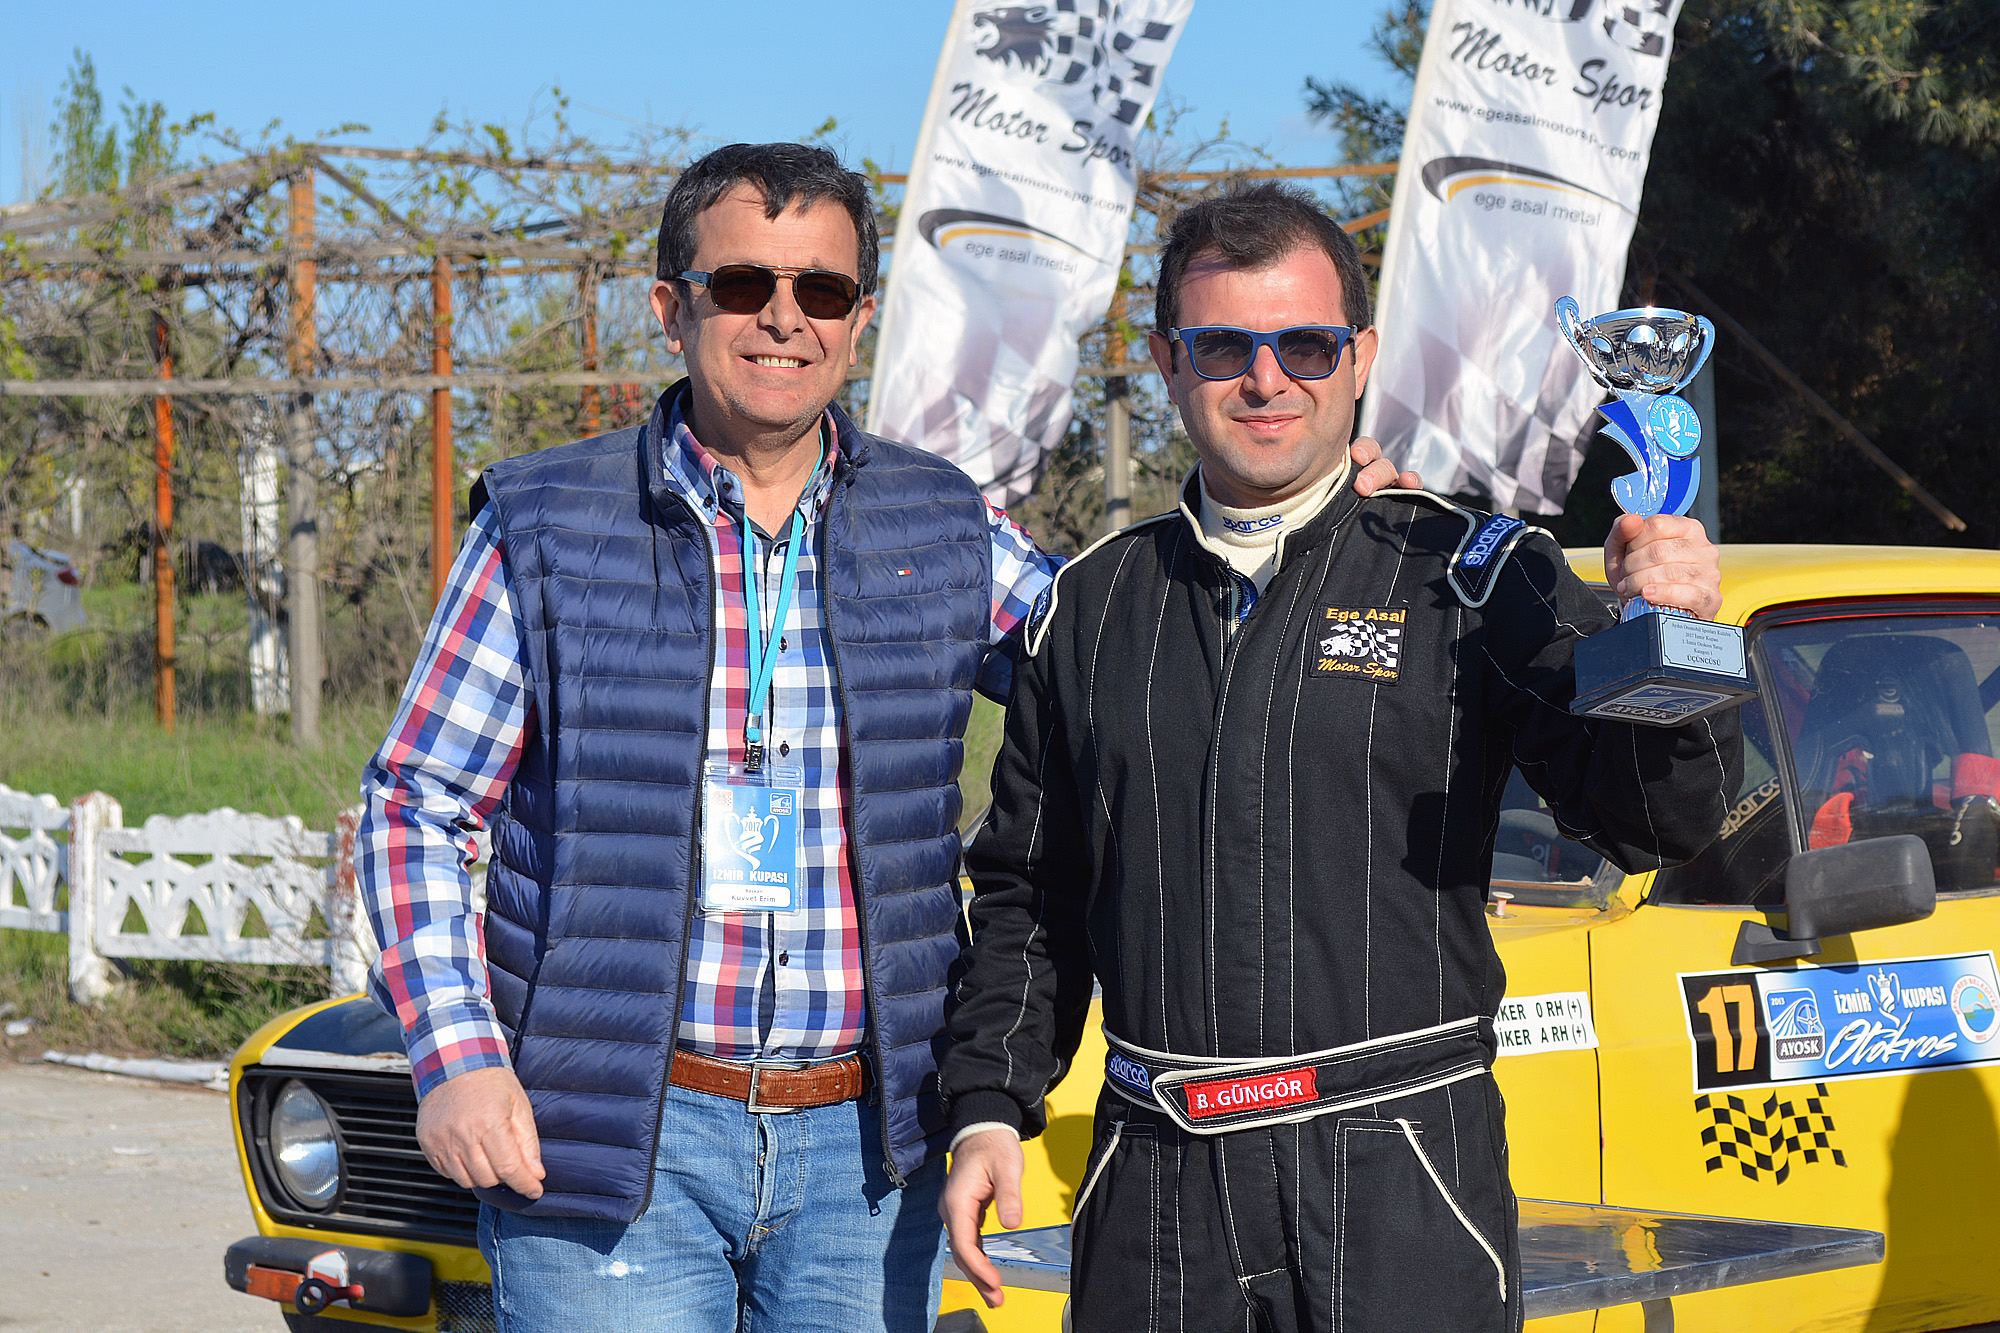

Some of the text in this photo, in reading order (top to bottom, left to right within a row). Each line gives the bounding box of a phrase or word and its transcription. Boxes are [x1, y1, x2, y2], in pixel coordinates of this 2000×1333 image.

[1450, 22, 1654, 114] Motor Spor
[949, 81, 1132, 170] Motor Spor
[1435, 96, 1641, 162] www.egeasalmotorspr.com
[1474, 192, 1602, 227] ege asal metal
[964, 240, 1079, 275] ege asal metal
[1223, 514, 1284, 534] sparco
[1464, 517, 1520, 566] sparco
[1326, 608, 1406, 624] Ege Asal
[1318, 658, 1398, 679] Motor Spor
[1607, 706, 1668, 719] AYOSK
[745, 821, 760, 832] 2017
[712, 867, 788, 884] İZMİR KUPASI
[1546, 1000, 1564, 1017] RH
[1770, 997, 1785, 1006] 2013
[1833, 986, 1948, 1014] İZMİR KUPASI
[1496, 1027, 1532, 1047] İKER
[1541, 1027, 1549, 1043] A
[1552, 1025, 1568, 1042] RH
[1697, 984, 1758, 1074] 17
[1825, 1010, 1958, 1070] Otokros
[1780, 1039, 1820, 1057] AYOSK
[1217, 1077, 1304, 1105] GÜNGÖR
